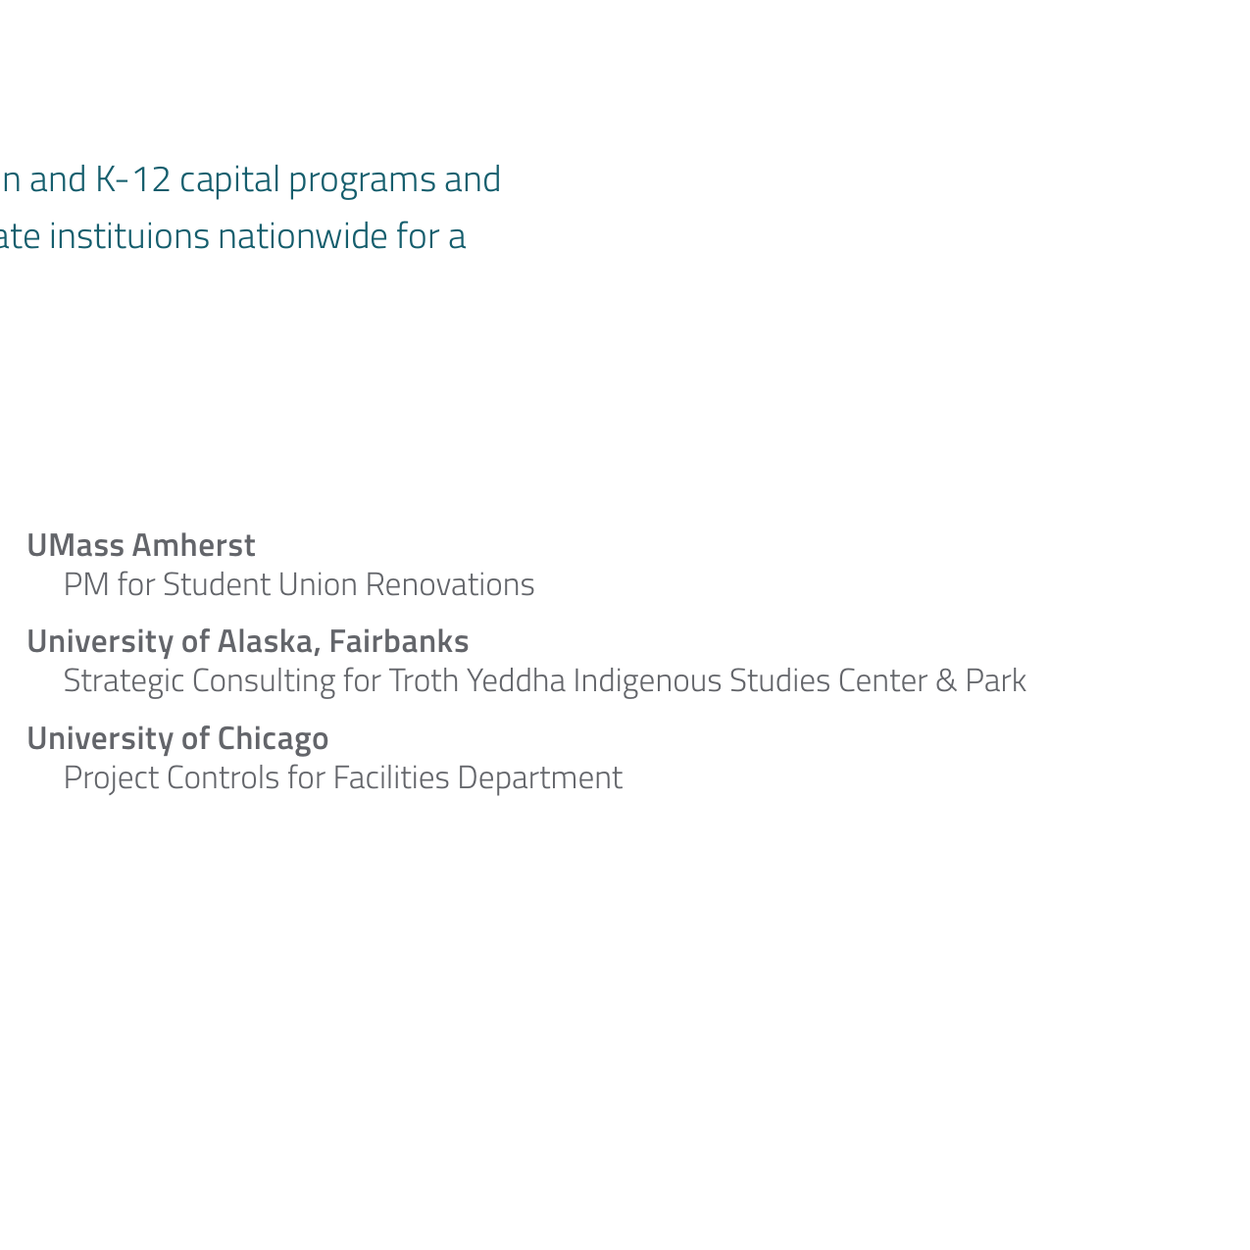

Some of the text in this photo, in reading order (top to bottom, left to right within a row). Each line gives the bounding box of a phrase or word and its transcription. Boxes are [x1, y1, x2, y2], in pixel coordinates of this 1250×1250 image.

[30, 163, 86, 193] and
[97, 164, 171, 192] K-12
[180, 163, 279, 201] capital
[290, 171, 436, 201] programs
[444, 163, 500, 193] and
[50, 221, 210, 250] instituions
[219, 220, 388, 250] nationwide
[396, 220, 441, 250] for
[448, 228, 467, 250] a
[27, 531, 256, 558] UMass Amherst
[65, 570, 535, 597] PM for Student Union Renovations
[27, 627, 469, 660] University of Alaska, Fairbanks
[64, 666, 1027, 700] Strategic Consulting for Troth Yeddha Indigenous Studies Center & Park
[27, 724, 329, 758] University of Chicago
[65, 763, 624, 797] Project Controls for Facilities Department
